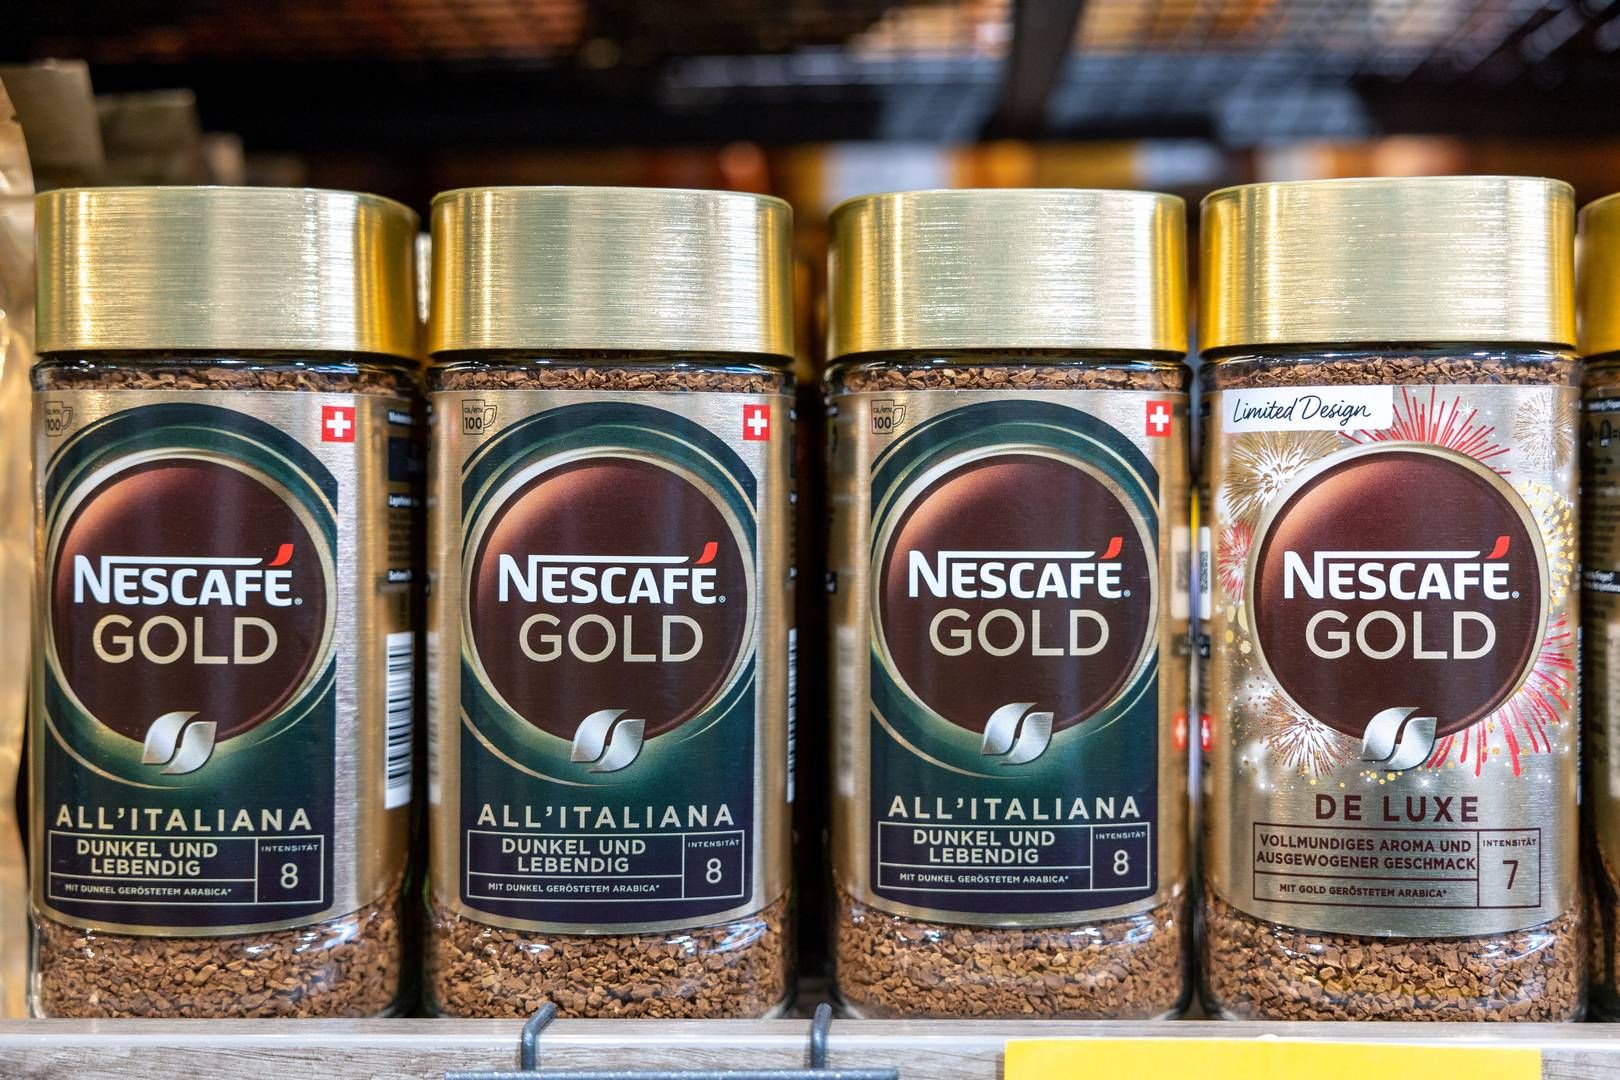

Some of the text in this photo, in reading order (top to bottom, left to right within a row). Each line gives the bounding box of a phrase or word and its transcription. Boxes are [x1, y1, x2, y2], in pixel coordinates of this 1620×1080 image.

[1233, 395, 1371, 426] Limited Design
[464, 416, 482, 430] 100
[873, 416, 891, 429] 100
[92, 614, 278, 664] GOLD
[519, 613, 704, 663] GOLD
[929, 608, 1110, 657] GOLD
[1305, 610, 1496, 660] GOLD
[56, 804, 312, 831] ALL'ITALIANA
[477, 804, 735, 828] ALL'ITALIANA
[888, 795, 1140, 820] ALL'ITALIANA
[1315, 794, 1479, 822] DE LUXE
[502, 838, 646, 855] DUNKEL UND
[913, 829, 1055, 847] DUNKEL UND
[1260, 833, 1471, 853] VOLLMUNDIGES AROMA UND
[77, 839, 218, 858] DUNKEL UND
[929, 848, 1039, 864] LEBENDIG
[91, 858, 201, 876] LEBENDIG
[518, 857, 629, 872] LEBENDIG
[705, 858, 723, 884] 8
[1113, 850, 1130, 876] 8
[1256, 851, 1476, 871] AUSGEWOGENER GESCHMACK
[280, 863, 299, 889] 8
[900, 873, 915, 882] MIT
[918, 874, 955, 883] DUNKEL
[957, 874, 1020, 884] GERÖSTETEM
[1502, 860, 1519, 890] 7
[64, 883, 79, 893] MIT
[81, 884, 116, 895] DUNKEL
[118, 886, 182, 896] GERÖSTETEM
[488, 882, 503, 891] MIT
[506, 884, 544, 893] DUNKEL
[546, 884, 610, 894] GERÖSTETEM
[1279, 883, 1296, 894] MIT
[1298, 883, 1326, 895] GOLD
[1329, 885, 1395, 898] GERÖSTETEM
